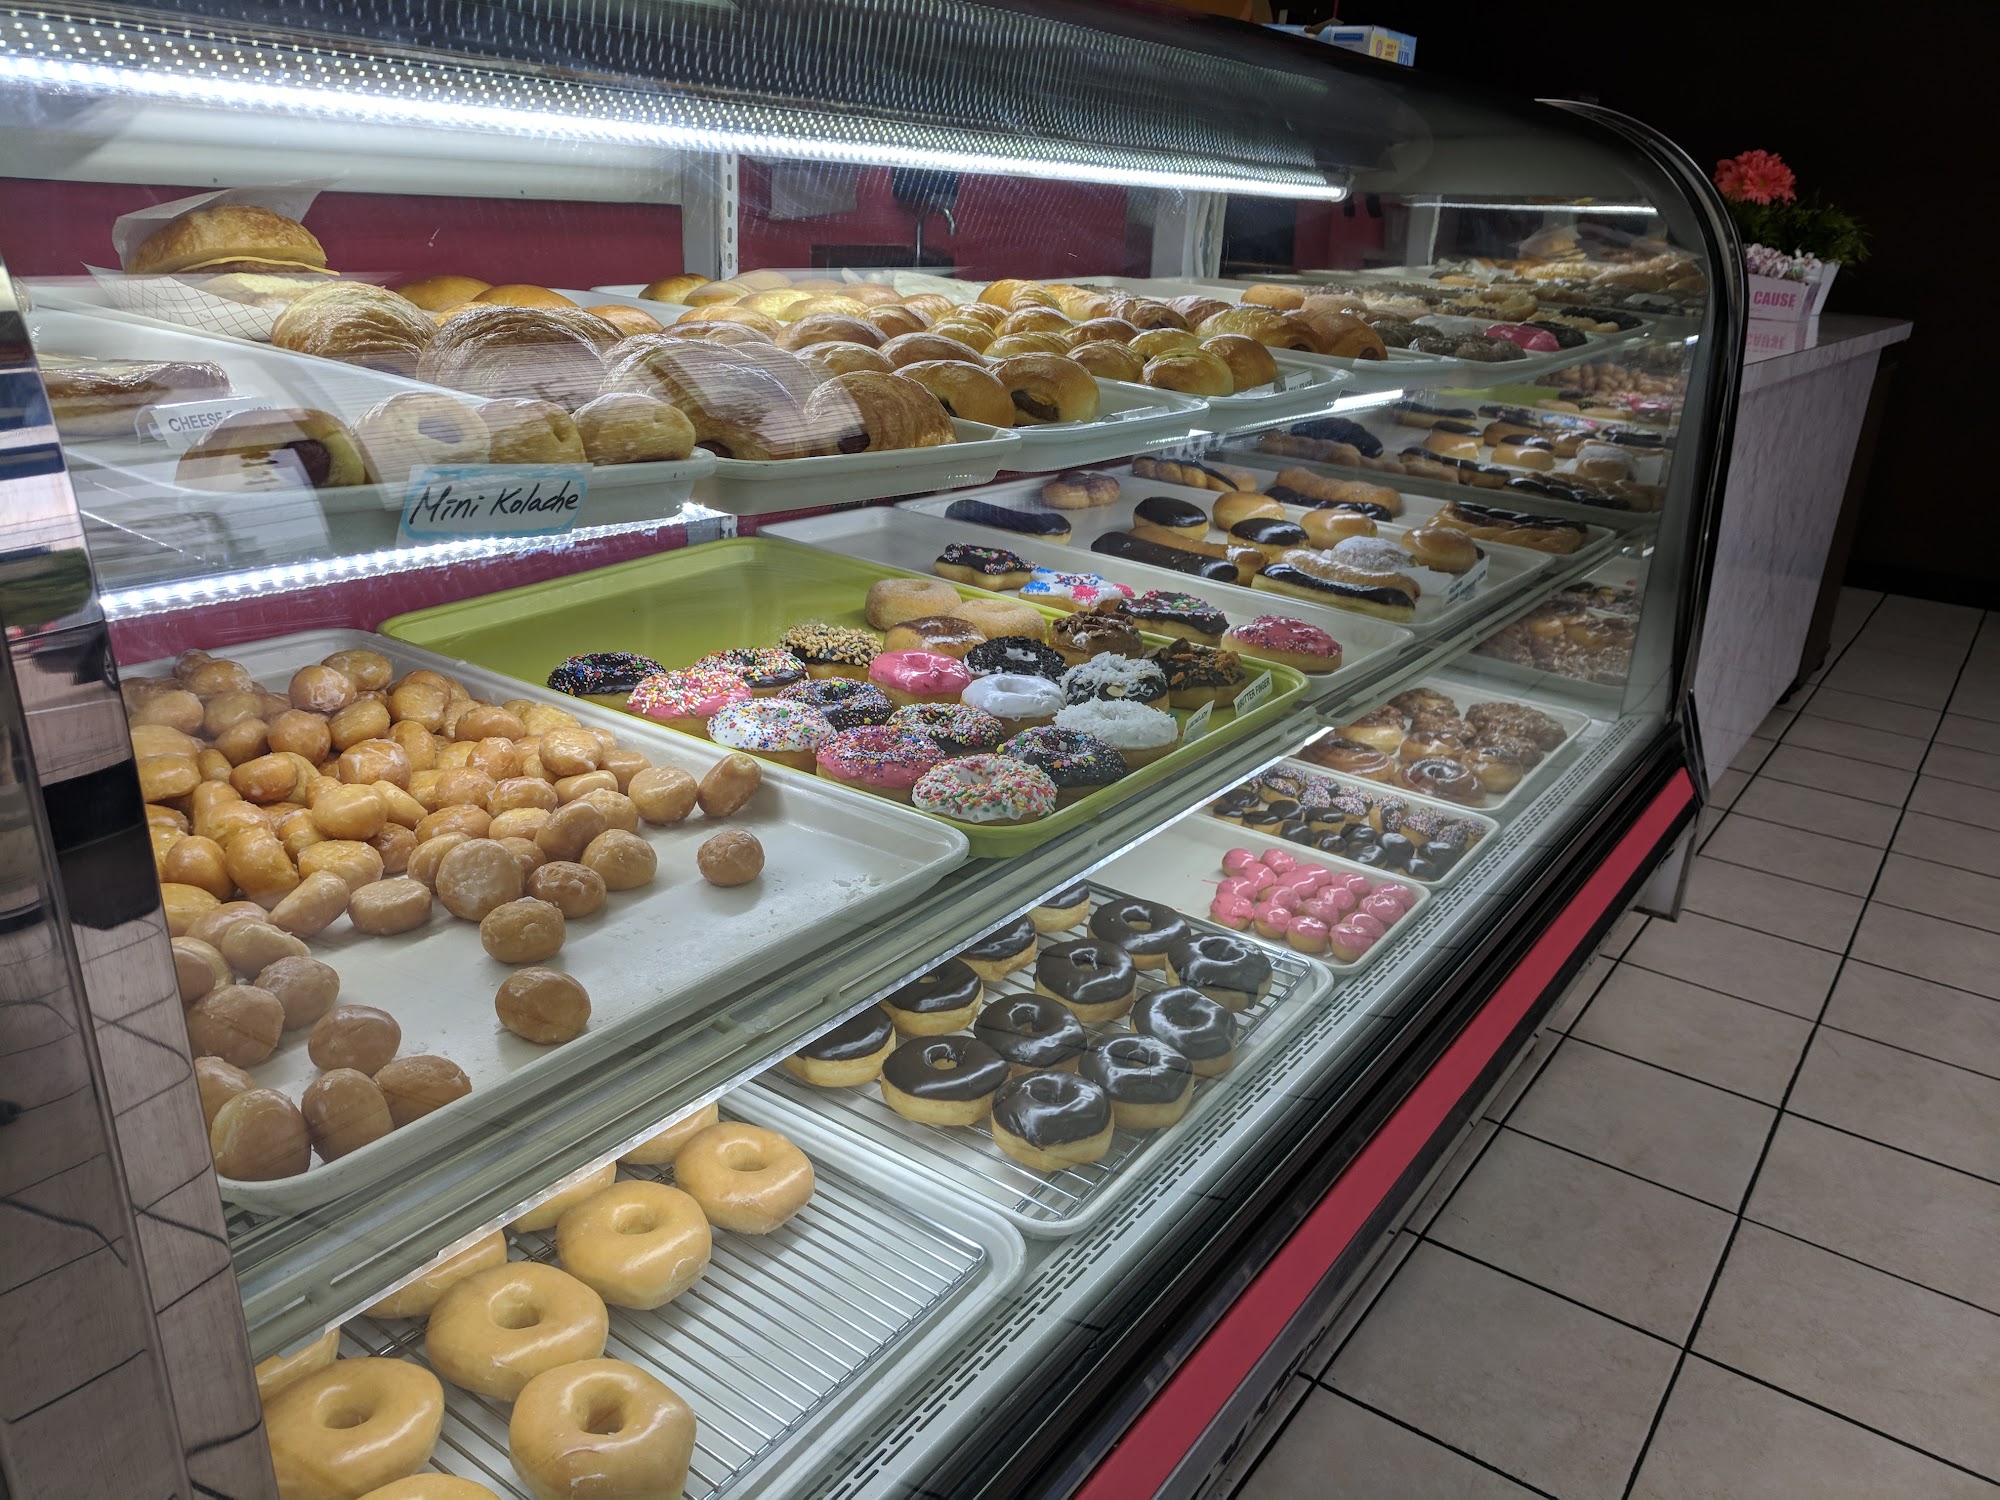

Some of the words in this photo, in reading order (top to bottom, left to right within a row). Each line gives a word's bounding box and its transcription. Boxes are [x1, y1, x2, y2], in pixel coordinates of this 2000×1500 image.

[1753, 291, 1797, 308] CAUSE
[168, 411, 224, 433] CHEESE
[409, 485, 484, 525] Mini
[489, 480, 579, 517] Kolache
[1255, 677, 1271, 695] FINGER
